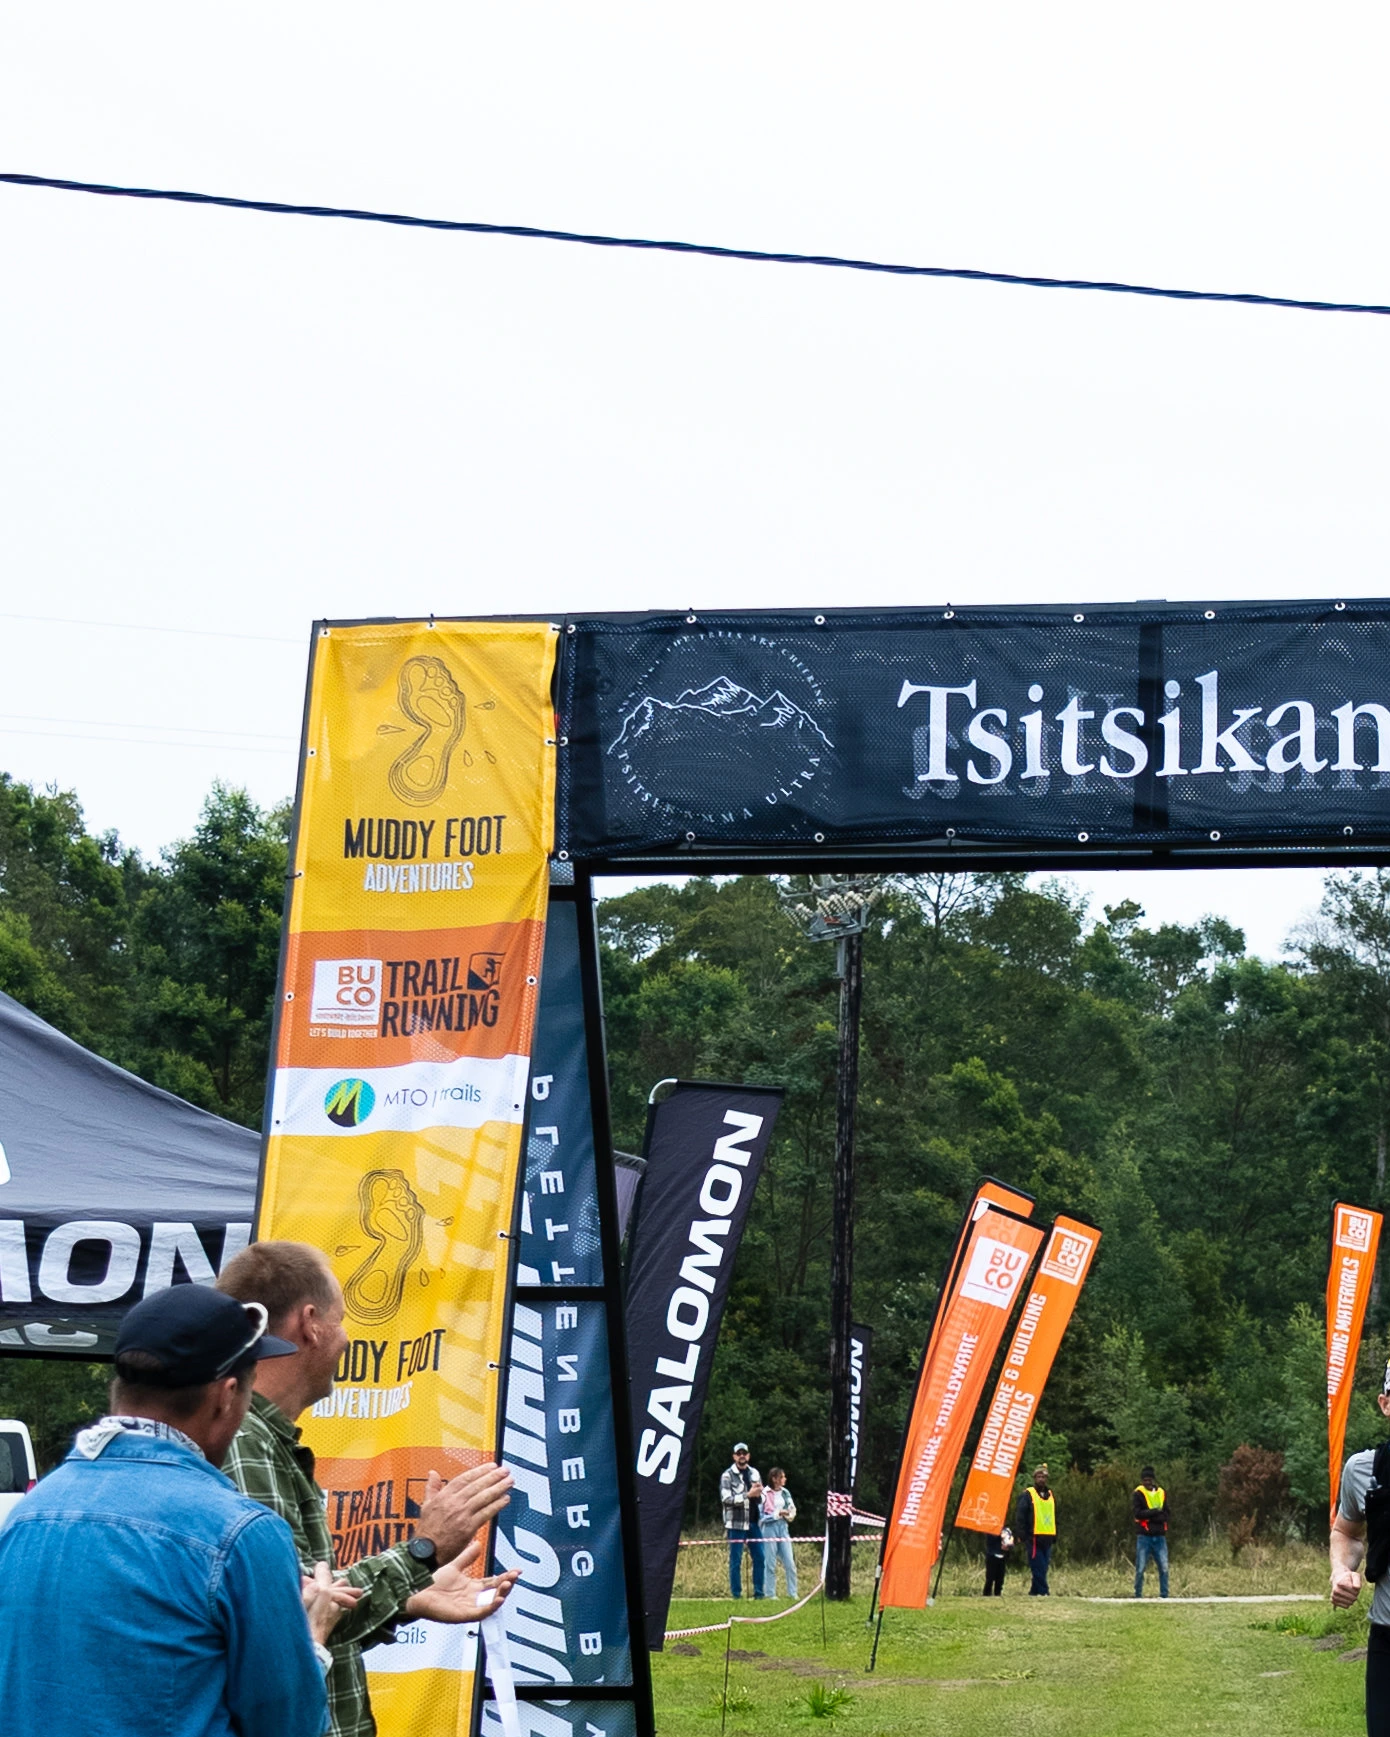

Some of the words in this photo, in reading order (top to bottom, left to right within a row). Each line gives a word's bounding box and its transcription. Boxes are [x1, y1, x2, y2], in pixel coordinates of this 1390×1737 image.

[765, 756, 821, 805] ULTRA
[344, 818, 435, 860] MUDDY
[444, 815, 507, 858] FOOT
[364, 861, 474, 894] ADVENTURES
[386, 957, 463, 997] TRAIL
[381, 989, 500, 1038] RUNNING
[384, 1088, 429, 1107] MTO
[439, 1083, 482, 1103] trails
[637, 1109, 764, 1486] SALOMON
[1334, 1256, 1360, 1333] MATERIALS
[333, 1339, 389, 1383] DDY
[396, 1328, 446, 1382] FOOT
[973, 1380, 1016, 1473] HARDWARE
[1010, 1292, 1047, 1367] BUILDING
[991, 1390, 1035, 1478] MATERIALS
[332, 1479, 400, 1531] TRAIL
[395, 1627, 427, 1645] ails
